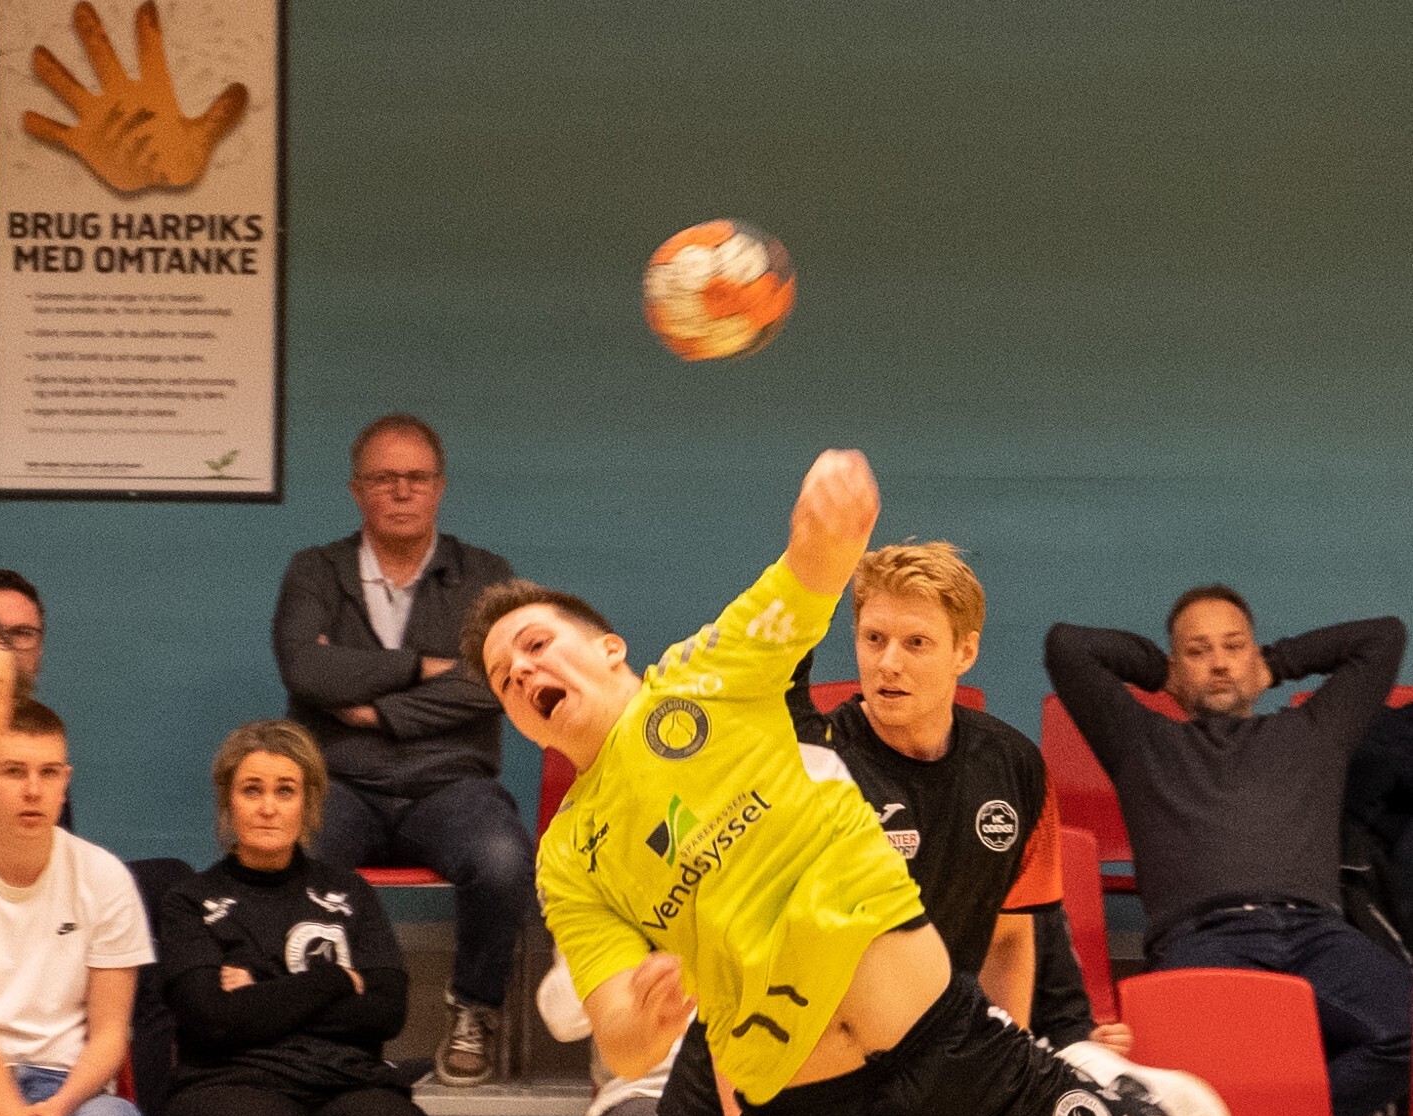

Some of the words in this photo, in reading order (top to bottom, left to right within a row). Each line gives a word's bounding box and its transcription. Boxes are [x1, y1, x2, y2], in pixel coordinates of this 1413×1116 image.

[8, 211, 101, 240] BRUG
[109, 212, 264, 242] HARPIKS
[13, 245, 85, 273] MED
[93, 246, 259, 275] OMTANKE
[641, 790, 772, 931] Vendsyssel
